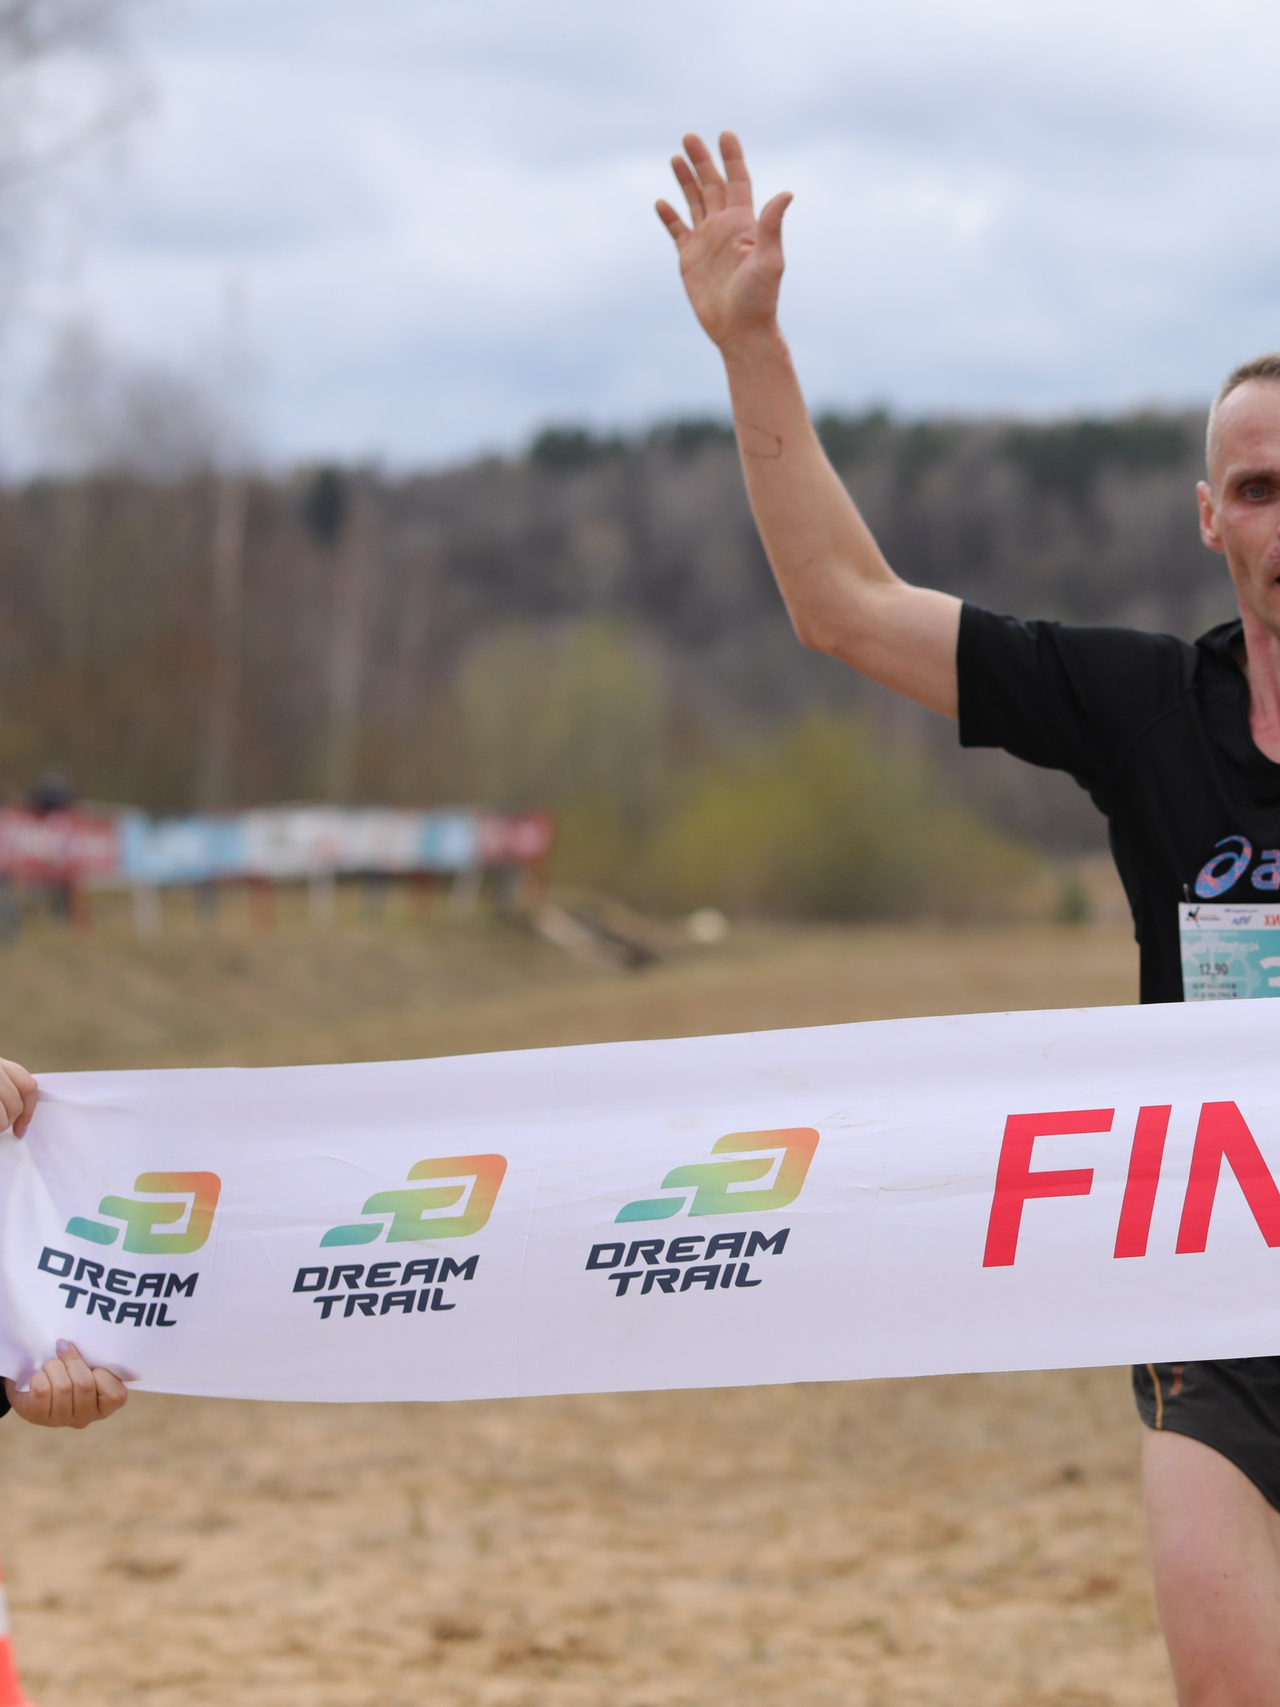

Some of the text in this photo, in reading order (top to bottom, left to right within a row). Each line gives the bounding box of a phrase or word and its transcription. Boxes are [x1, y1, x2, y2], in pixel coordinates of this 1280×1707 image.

[585, 1228, 791, 1271] DREAM
[37, 1246, 200, 1298] DREAM
[292, 1255, 480, 1294] DREAM
[607, 1262, 763, 1298] TRAIL
[58, 1283, 178, 1328] TRAIL
[312, 1287, 457, 1320] TRAIL
